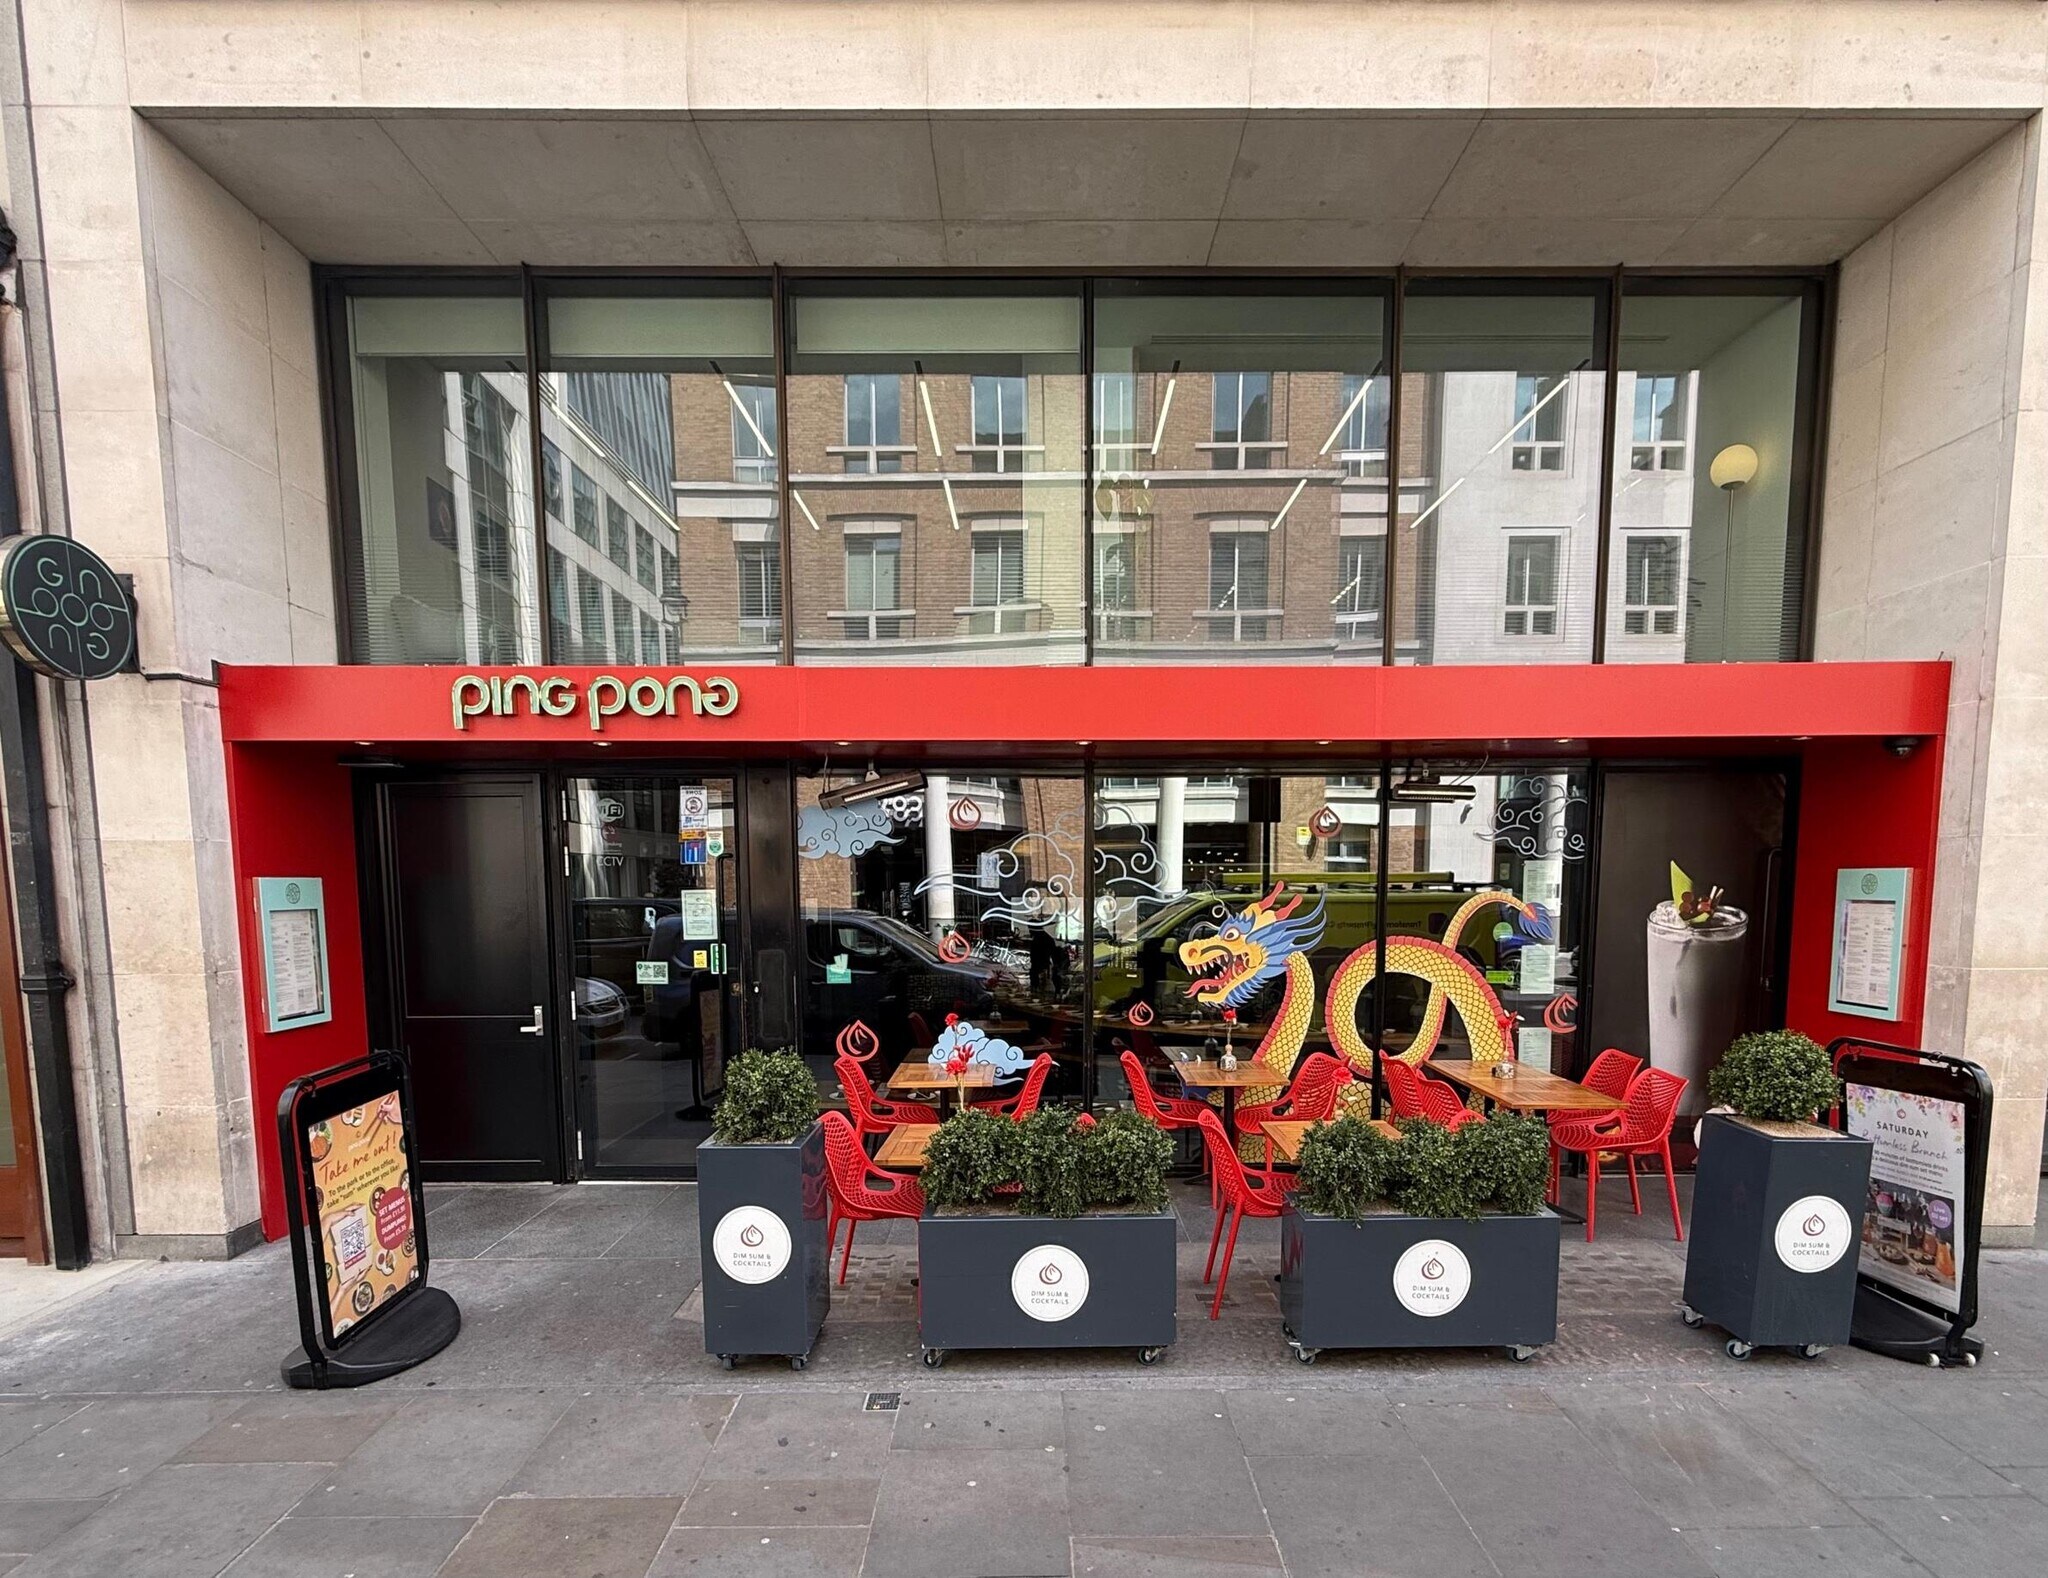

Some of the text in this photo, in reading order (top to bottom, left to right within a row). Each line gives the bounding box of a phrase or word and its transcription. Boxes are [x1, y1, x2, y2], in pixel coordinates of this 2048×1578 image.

[1876, 1121, 1929, 1139] SATURDAY
[319, 1160, 348, 1185] Take
[353, 1153, 369, 1168] me
[328, 1189, 336, 1197] To
[337, 1184, 346, 1192] the
[379, 1206, 388, 1217] SET
